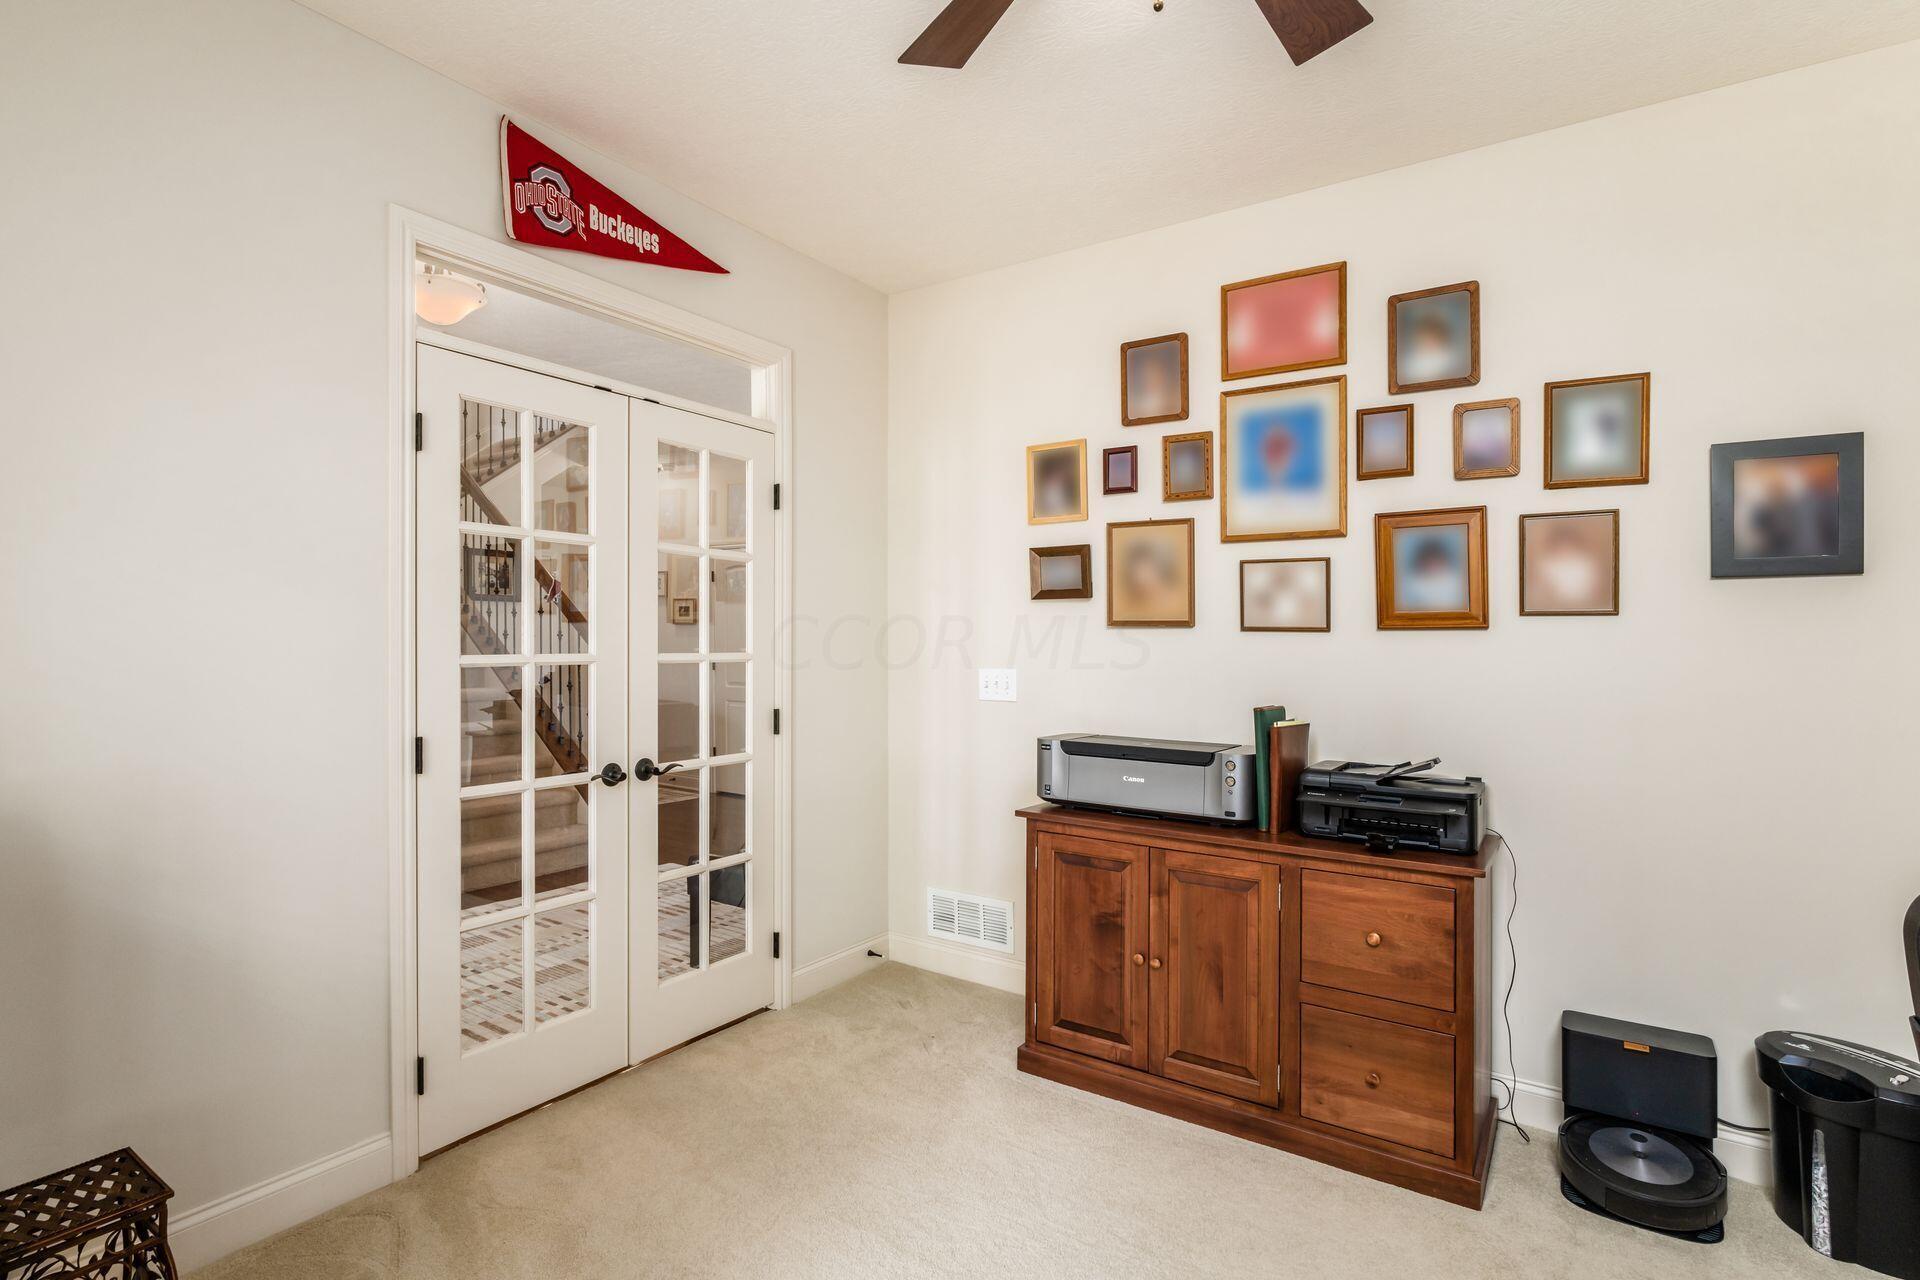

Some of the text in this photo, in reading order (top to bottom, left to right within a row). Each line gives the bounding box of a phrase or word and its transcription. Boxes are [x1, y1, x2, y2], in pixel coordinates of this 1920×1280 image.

[545, 183, 588, 242] STATE
[589, 203, 660, 254] Buckeyes
[1122, 775, 1145, 783] Canon
